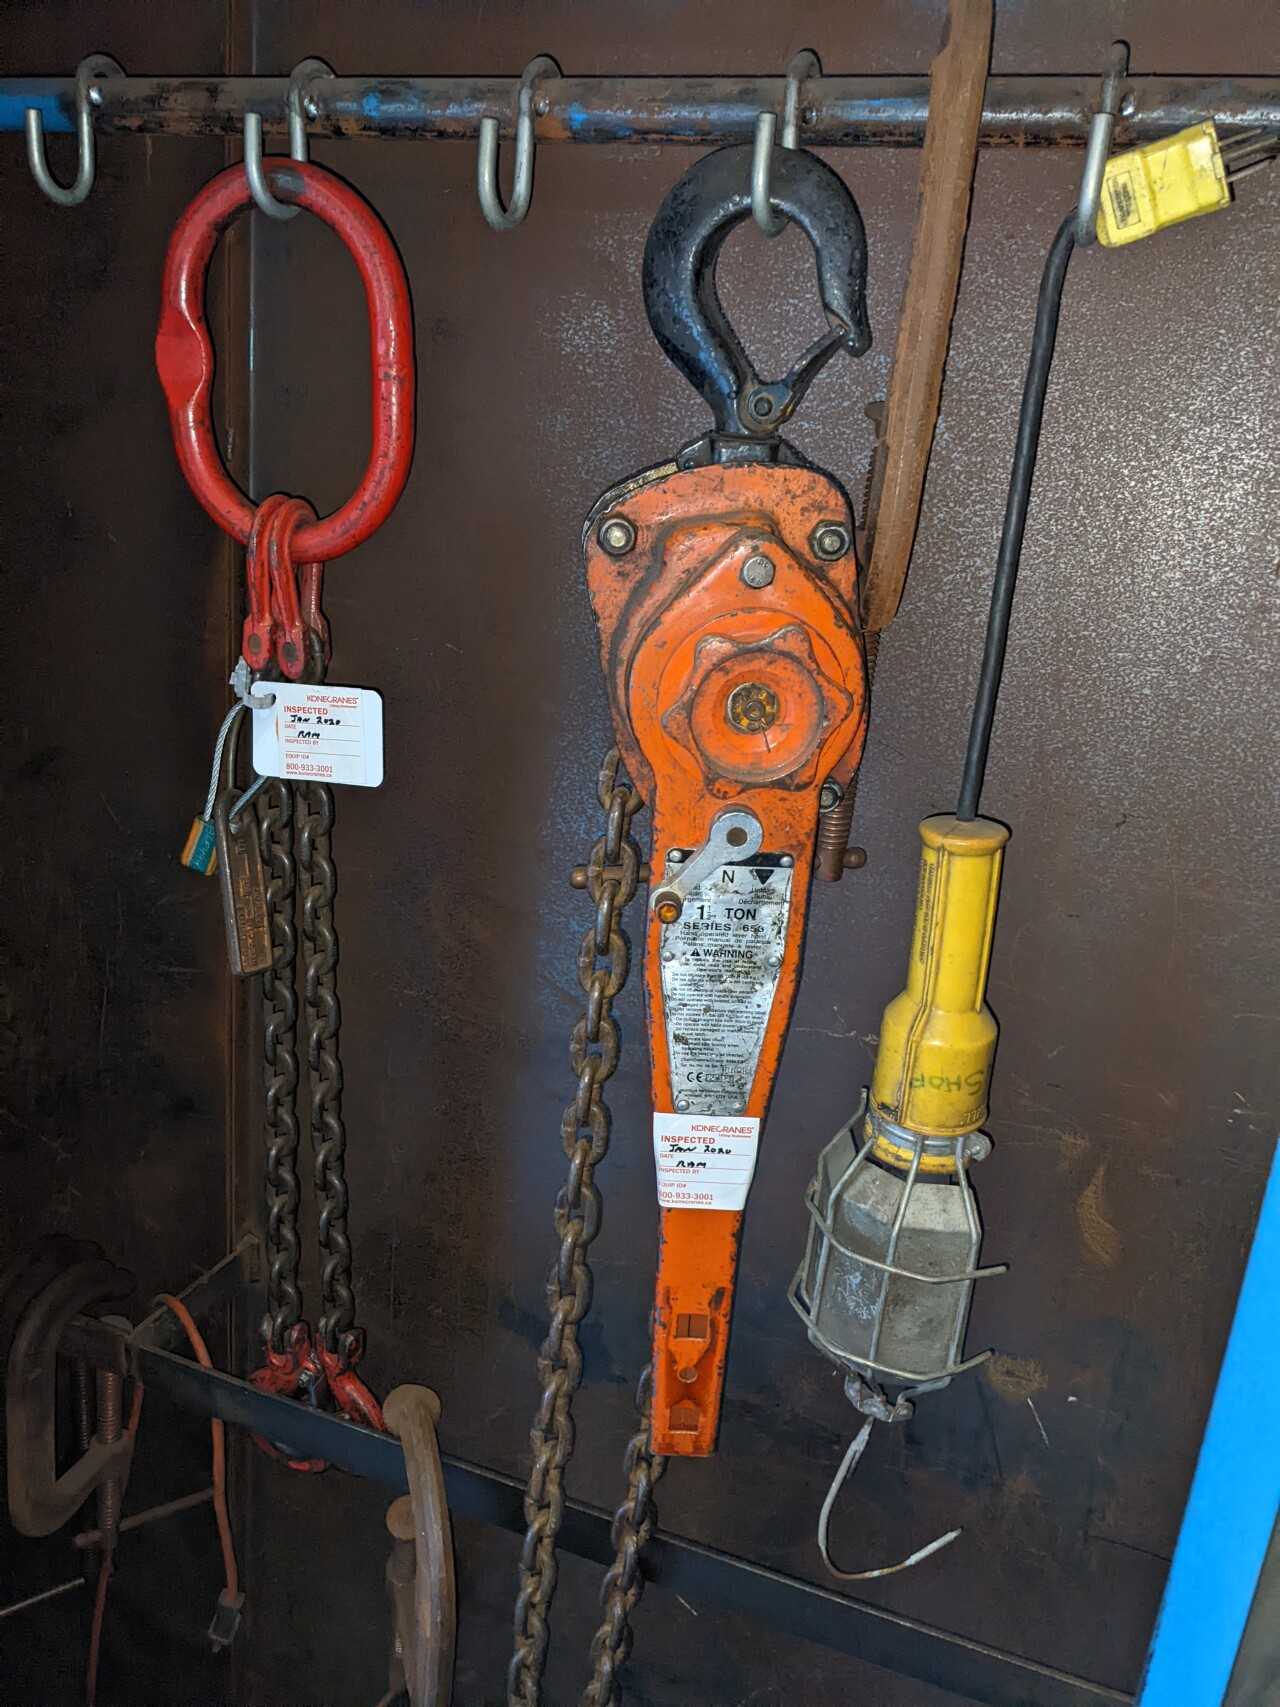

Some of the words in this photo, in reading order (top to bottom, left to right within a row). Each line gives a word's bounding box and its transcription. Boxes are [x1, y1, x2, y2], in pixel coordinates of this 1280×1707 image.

[306, 695, 358, 705] KONECRANES
[283, 705, 328, 715] INSPECTED
[316, 716, 341, 725] 2020
[286, 763, 333, 773] 800-933-3001
[722, 870, 735, 883] N
[725, 908, 757, 920] TON
[683, 922, 732, 931] SERIES
[703, 948, 753, 959] WARNING
[691, 1124, 753, 1135] KONECRANES
[661, 1135, 716, 1145] INSPECTED
[704, 1145, 732, 1154] 2020
